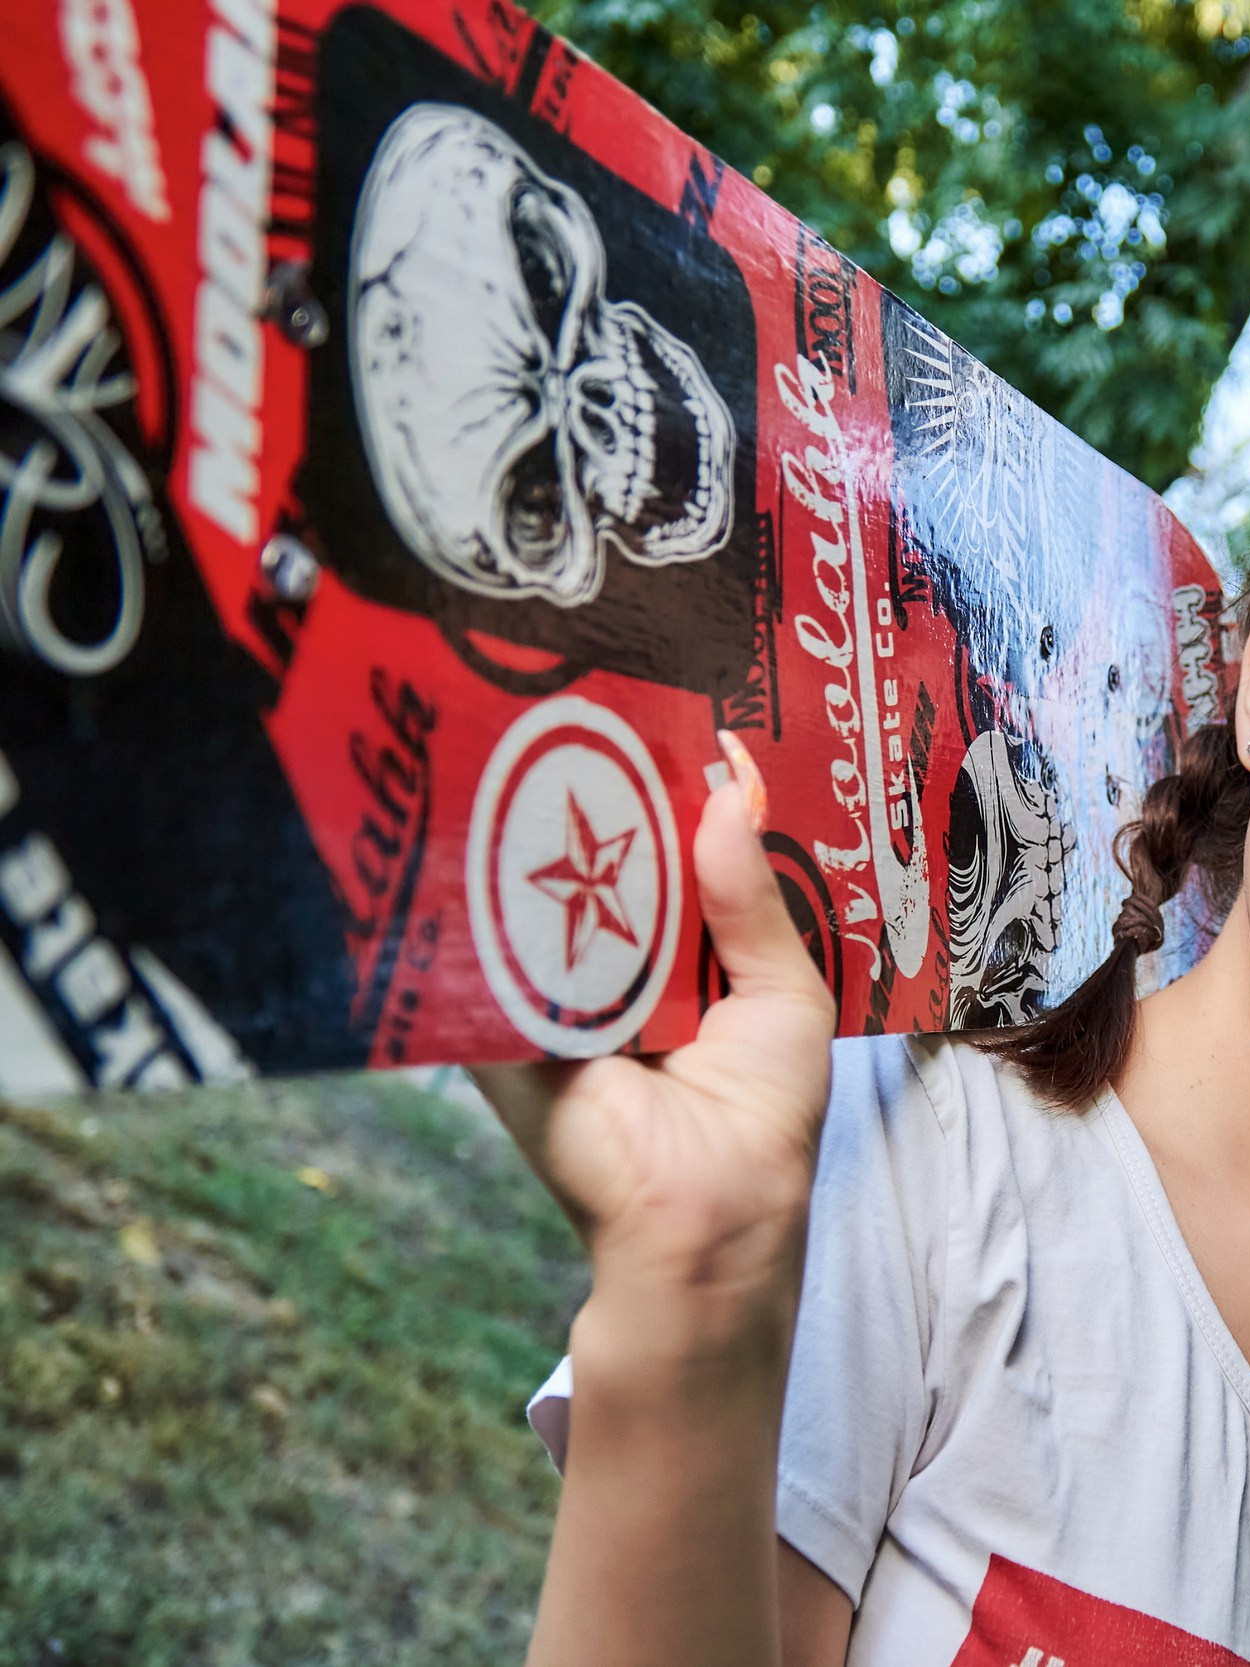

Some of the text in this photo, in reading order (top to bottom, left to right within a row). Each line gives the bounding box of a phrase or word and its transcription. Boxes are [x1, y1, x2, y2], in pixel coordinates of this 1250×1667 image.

[774, 349, 881, 981] Moolahh
[876, 582, 909, 831] Skate Co.
